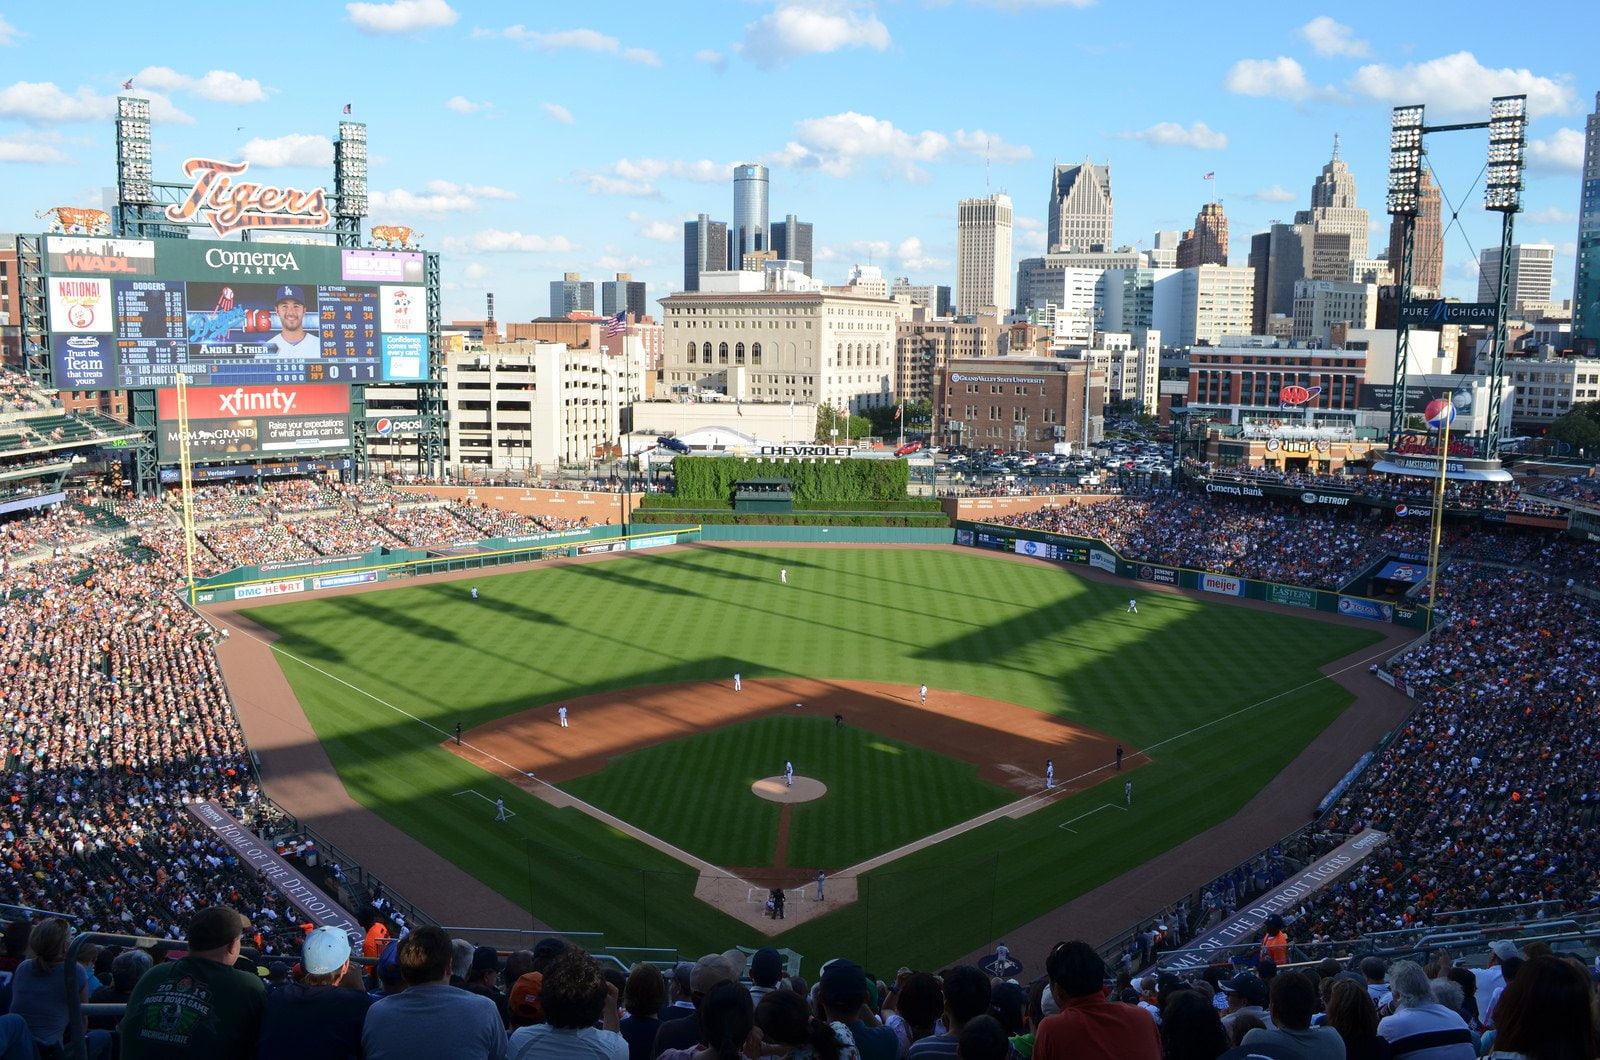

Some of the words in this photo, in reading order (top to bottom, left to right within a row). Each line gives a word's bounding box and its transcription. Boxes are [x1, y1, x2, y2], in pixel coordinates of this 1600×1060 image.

[165, 157, 331, 238] Tigers
[64, 255, 137, 272] WADL
[232, 266, 276, 275] PARK
[133, 282, 166, 291] DODGERS
[363, 312, 373, 320] 34
[1403, 308, 1429, 316] PURE
[1423, 301, 1495, 323] MICHIGAN
[243, 310, 271, 333] 16
[323, 330, 334, 338] 64
[344, 330, 355, 338] 22
[365, 330, 374, 338] 17
[199, 344, 233, 354] ANDRE
[235, 344, 269, 354] ETHIER
[322, 348, 337, 356] .314
[346, 348, 355, 356] 12
[64, 357, 104, 370] Team
[139, 365, 151, 374] LOS
[152, 364, 178, 373] ANGELES
[179, 364, 207, 373] DODGERS
[329, 366, 339, 378] 0
[349, 366, 357, 378] 1
[367, 366, 374, 378] 1
[139, 376, 169, 385] DETROIT
[219, 388, 297, 415] xfinity
[269, 421, 287, 429] Raise
[304, 419, 344, 428] expectations
[393, 418, 422, 432] pepsi
[168, 431, 197, 441] MGM
[214, 428, 255, 439] GRAND
[302, 428, 319, 436] bank
[334, 427, 344, 435] be.
[112, 439, 129, 447] SPA
[185, 438, 240, 446] DETROIT
[1283, 441, 1314, 452] JUNGLE
[761, 446, 854, 456] CHEVROLET
[207, 469, 236, 477] Verlander
[1243, 486, 1263, 497] Bank
[1319, 496, 1350, 505] DETROIT
[1408, 507, 1431, 518] pepsi
[517, 534, 540, 542] University
[1154, 568, 1174, 577] JIMMY
[1154, 574, 1174, 582] JOHN'S
[1206, 578, 1236, 591] meijer
[238, 588, 262, 597] DMC
[1272, 585, 1311, 599] EASTERN
[218, 823, 253, 849] HOME
[247, 848, 267, 861] OF
[261, 861, 289, 880] THE
[282, 878, 338, 920] DETROIT
[1219, 917, 1255, 938] THE
[1248, 880, 1312, 920] DETROIT
[1303, 854, 1351, 881] TIGERS
[157, 984, 173, 992] 20
[193, 988, 208, 999] 14
[143, 995, 162, 1004] ROSE
[164, 995, 187, 1006] BOWL
[187, 999, 210, 1016] GAME
[140, 1029, 169, 1041] MICHIGAN
[169, 1033, 189, 1044] STATE
